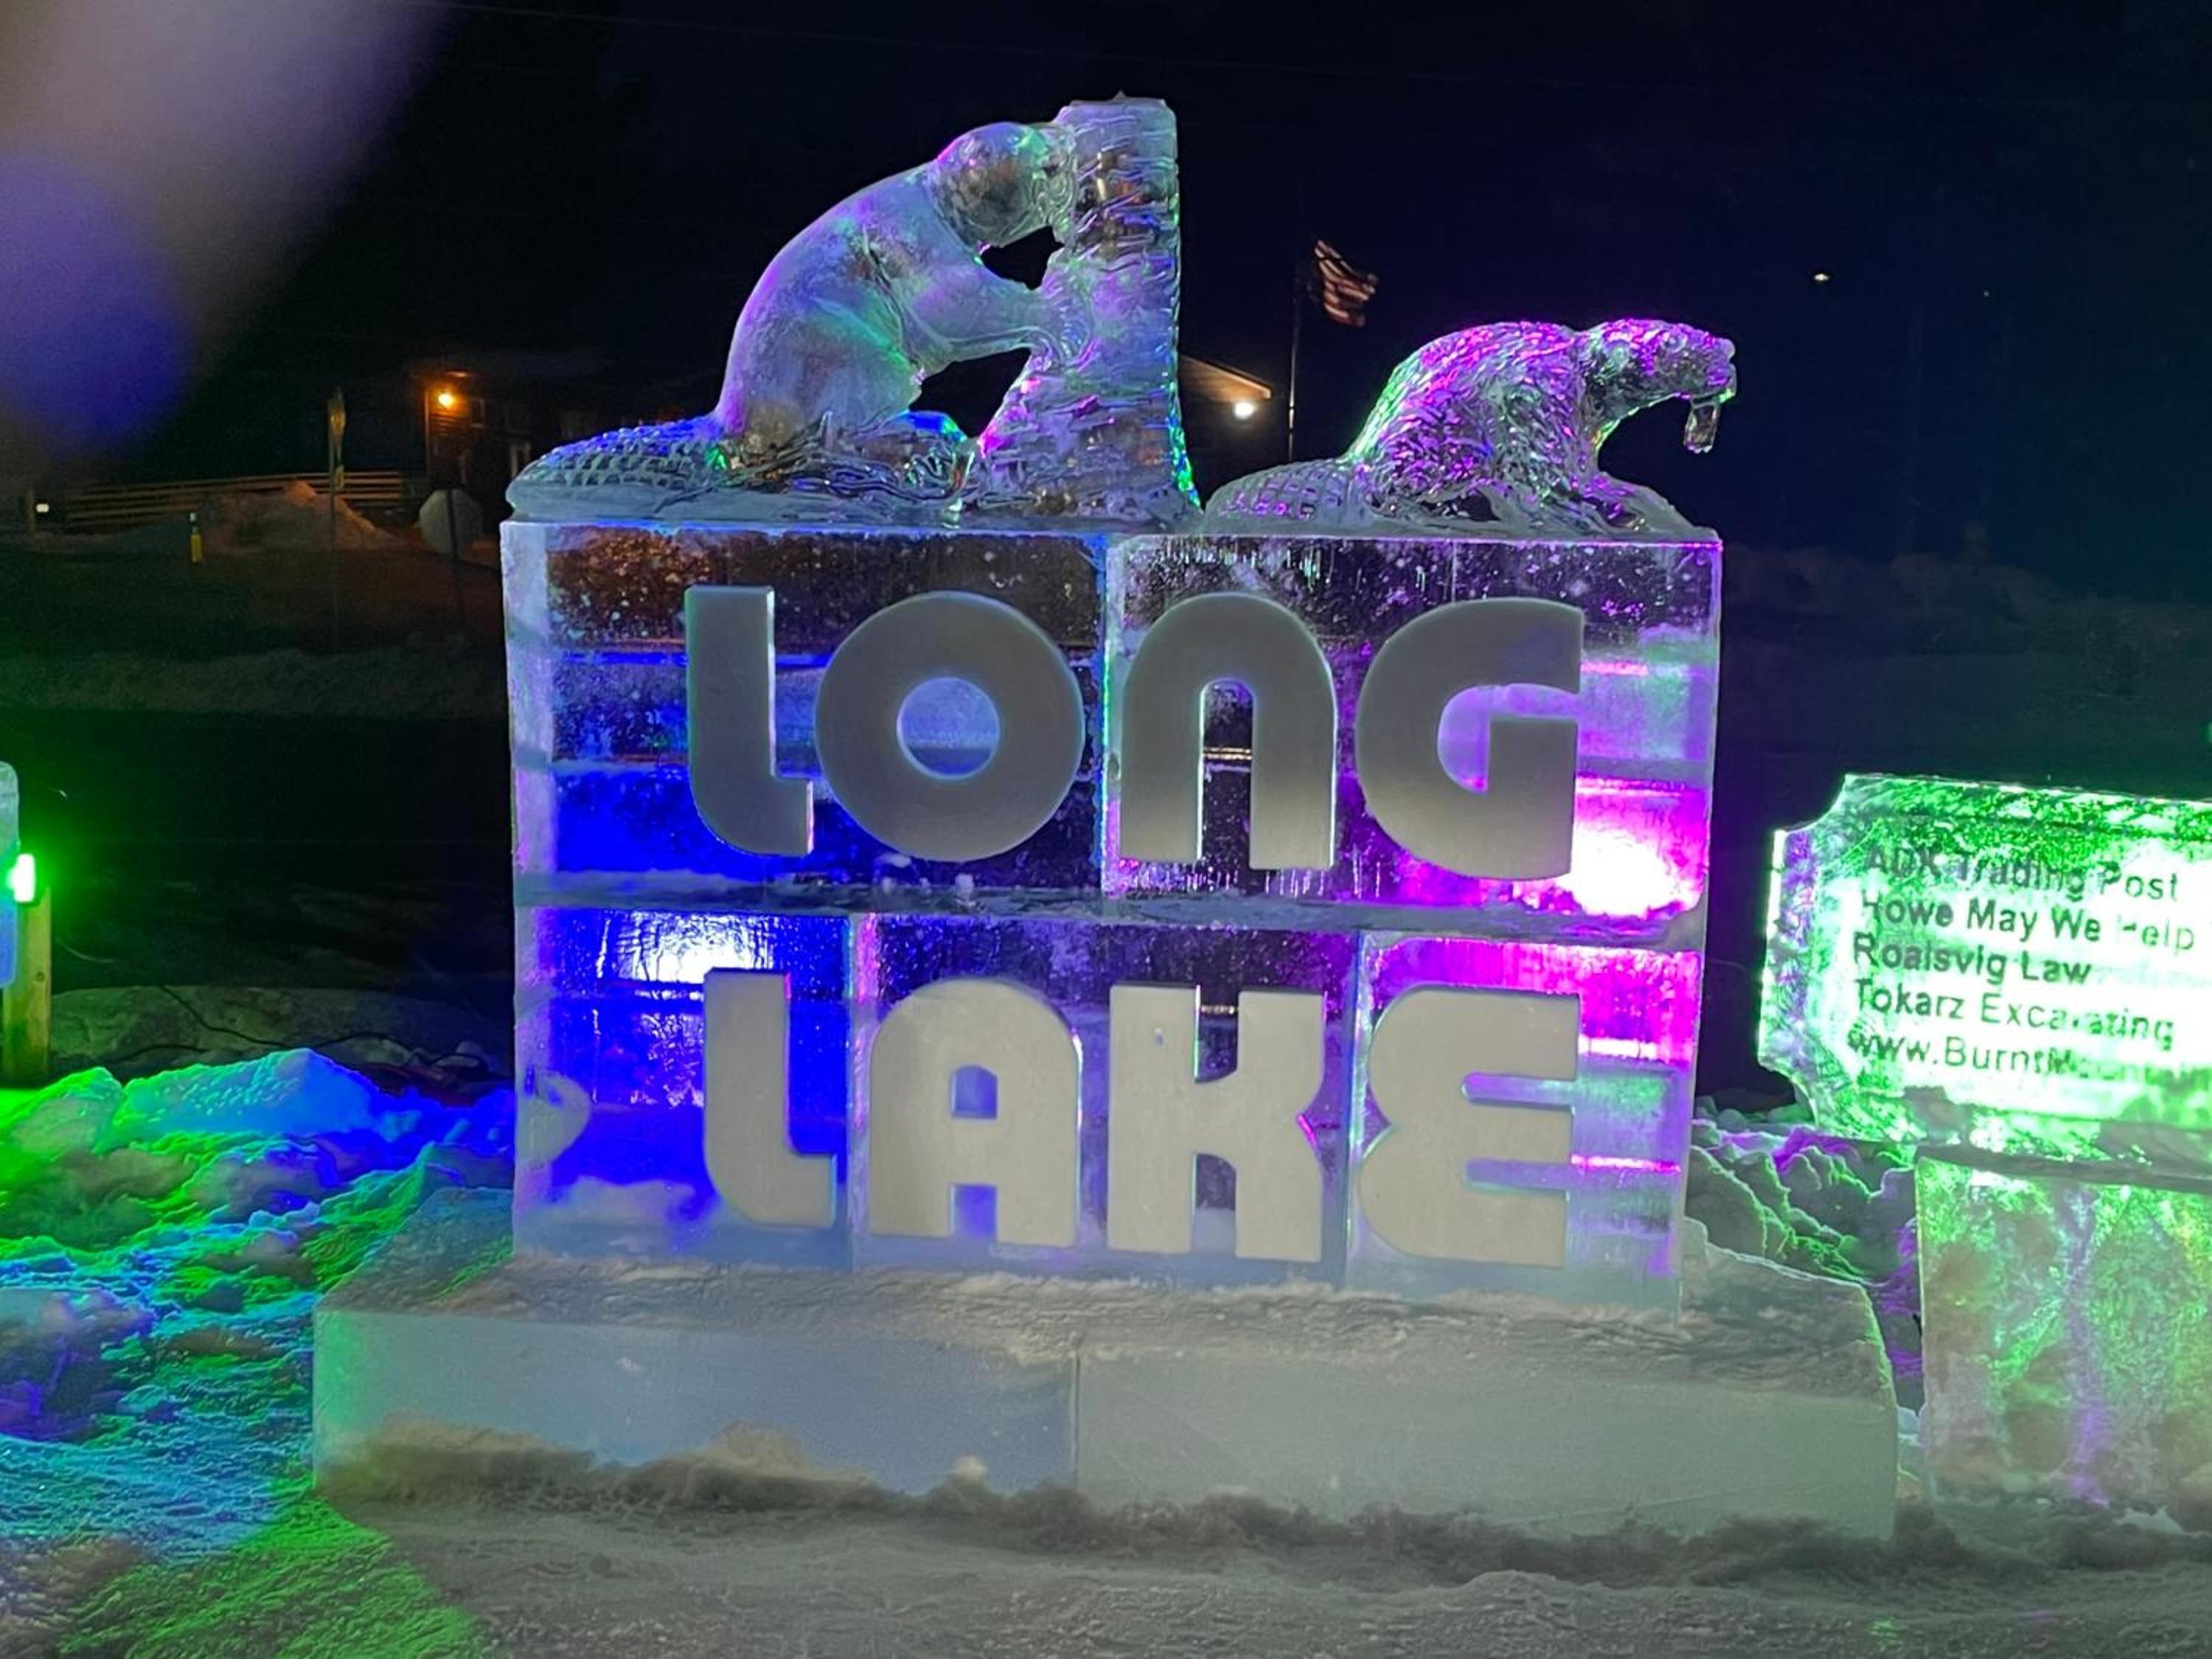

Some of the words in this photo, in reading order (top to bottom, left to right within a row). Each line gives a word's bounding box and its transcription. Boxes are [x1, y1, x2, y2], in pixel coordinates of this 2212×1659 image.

[684, 585, 1584, 881] LONG
[1954, 849, 2086, 902] Trading
[2101, 860, 2179, 901] Post
[1966, 898, 2038, 942] May
[2051, 907, 2101, 942] We
[2020, 950, 2091, 986] Law
[1854, 978, 1966, 1020] Tokarz
[1981, 992, 2174, 1052] Excaating
[702, 969, 1581, 1267] LAKE
